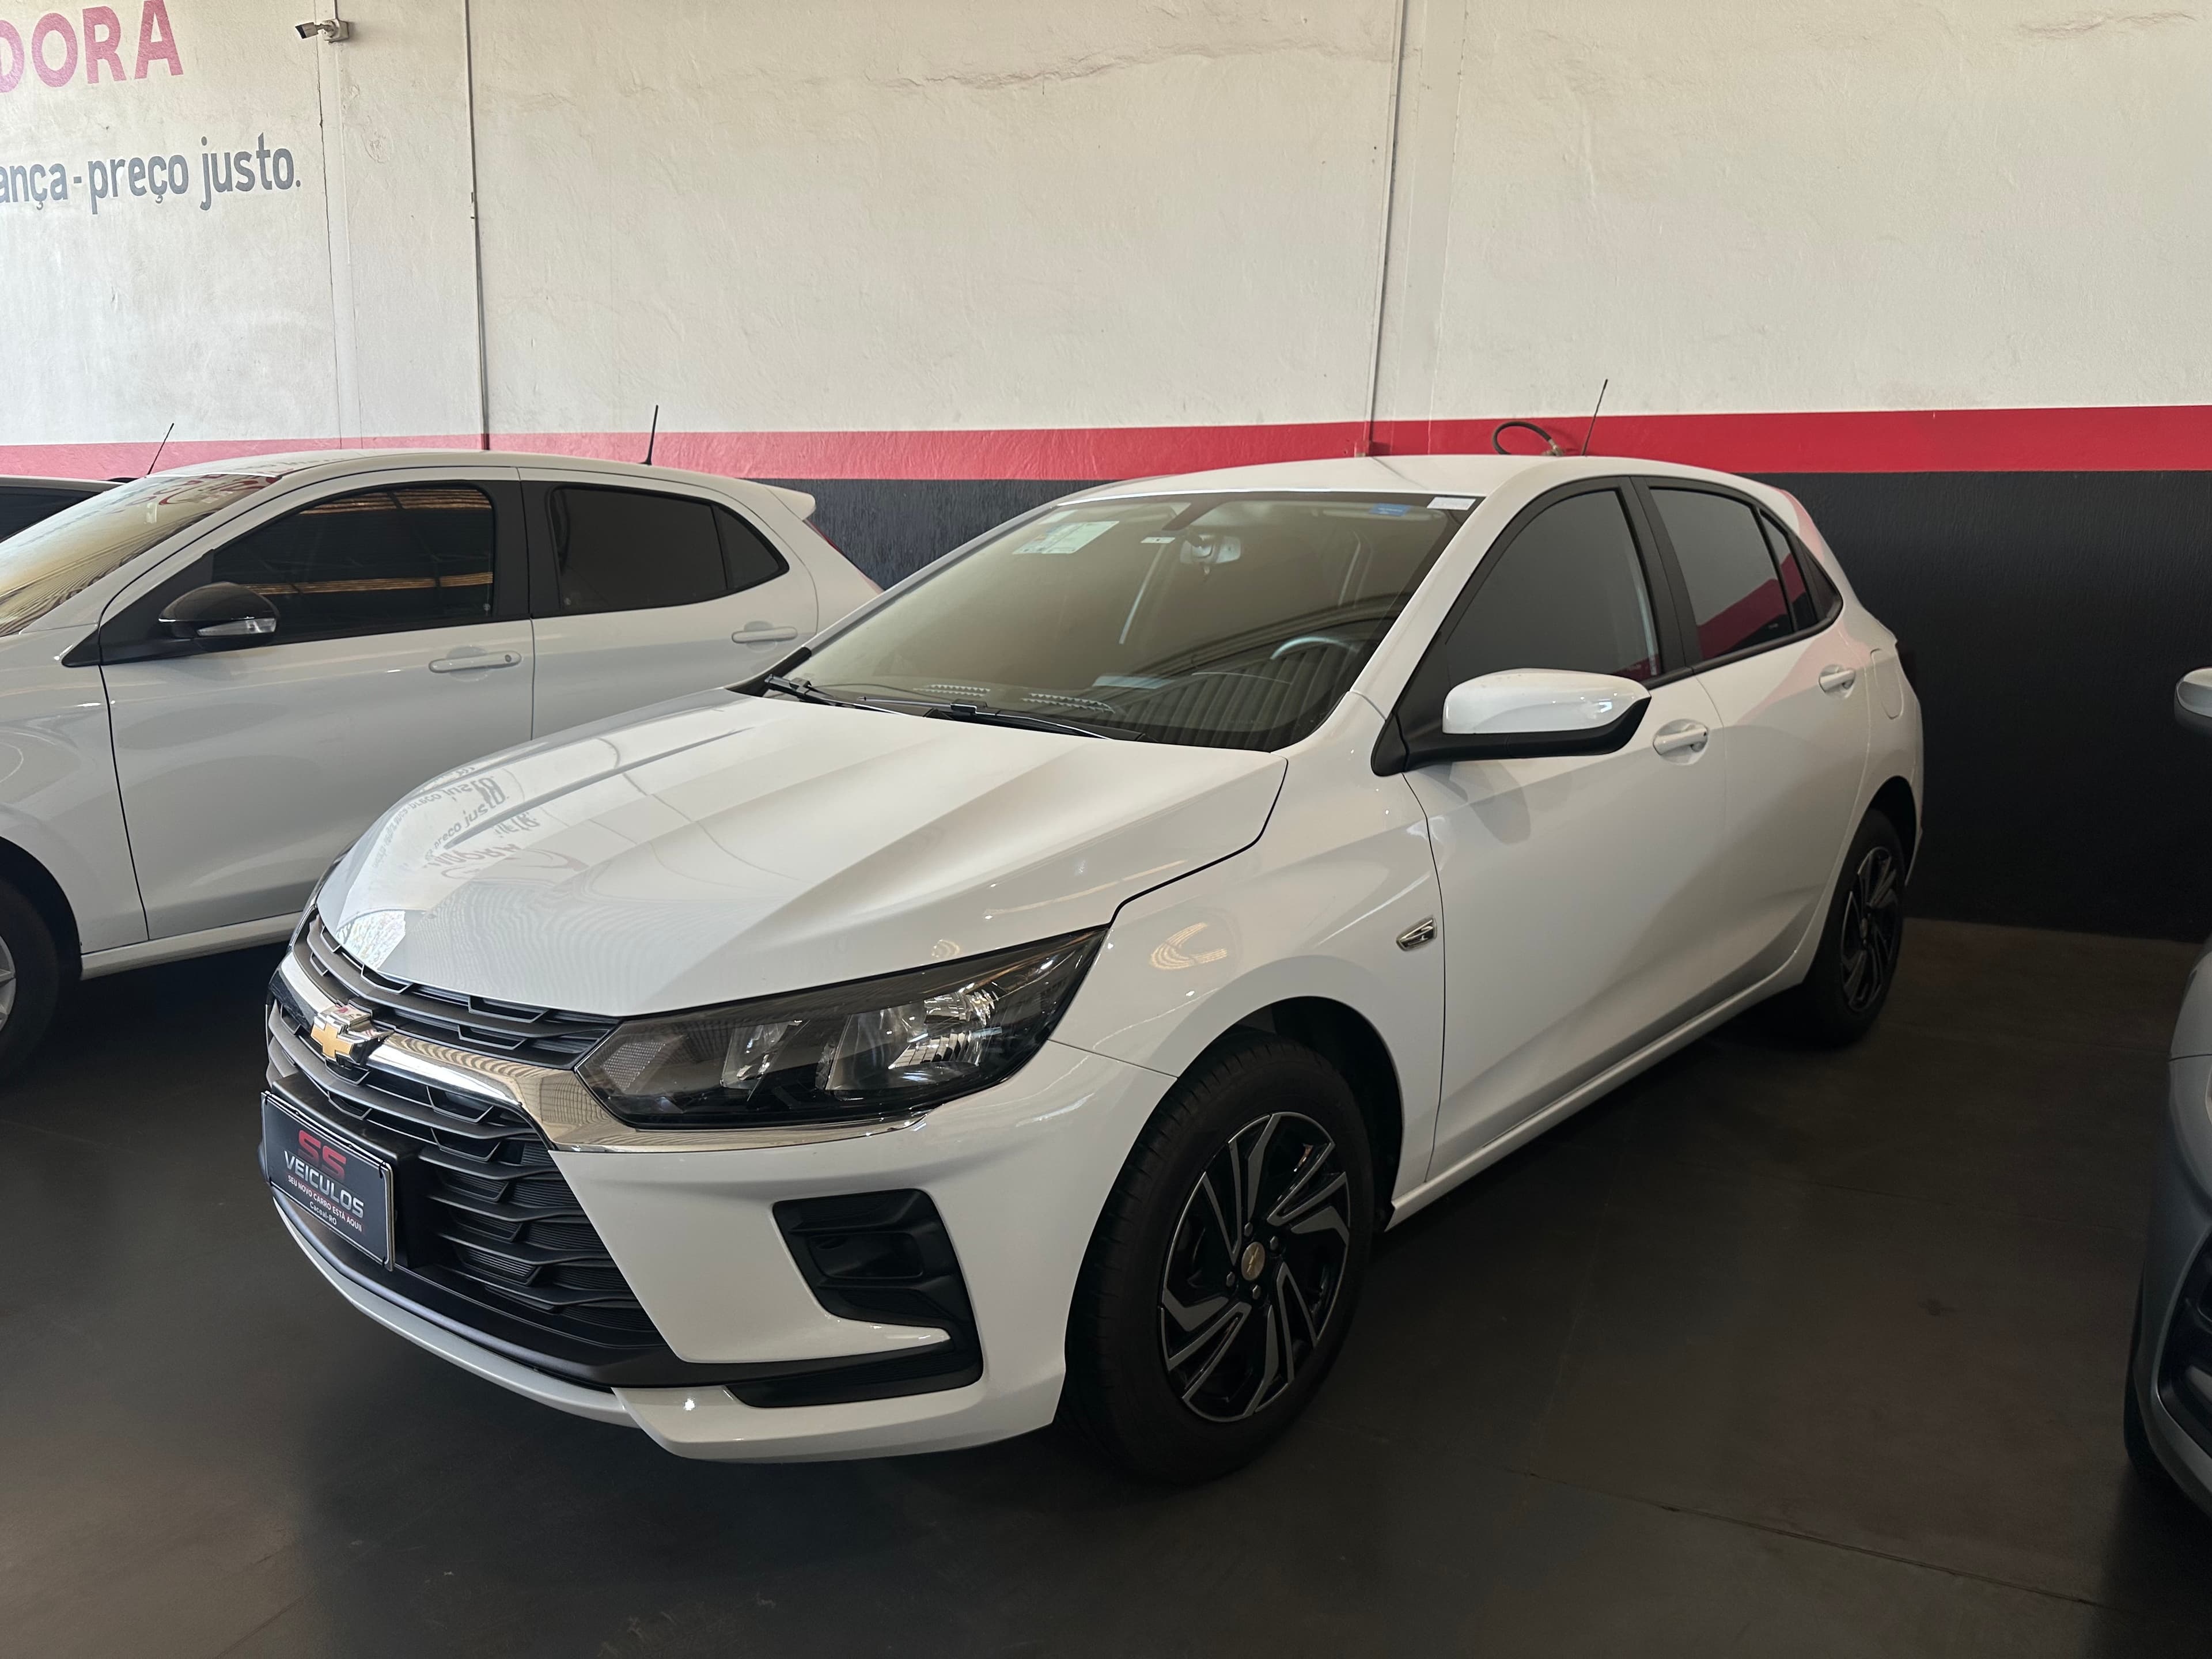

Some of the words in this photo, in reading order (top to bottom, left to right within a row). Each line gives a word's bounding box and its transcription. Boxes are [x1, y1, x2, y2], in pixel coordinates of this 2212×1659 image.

[199, 133, 301, 211] justo.
[298, 1130, 347, 1181] SS
[284, 1151, 364, 1218] VEICULOS
[288, 1175, 297, 1187] SEU
[298, 1182, 313, 1197] NOVO
[313, 1194, 332, 1210] CARRO
[332, 1206, 346, 1221] ESTÁ
[309, 1201, 337, 1225] Cacoal-RO
